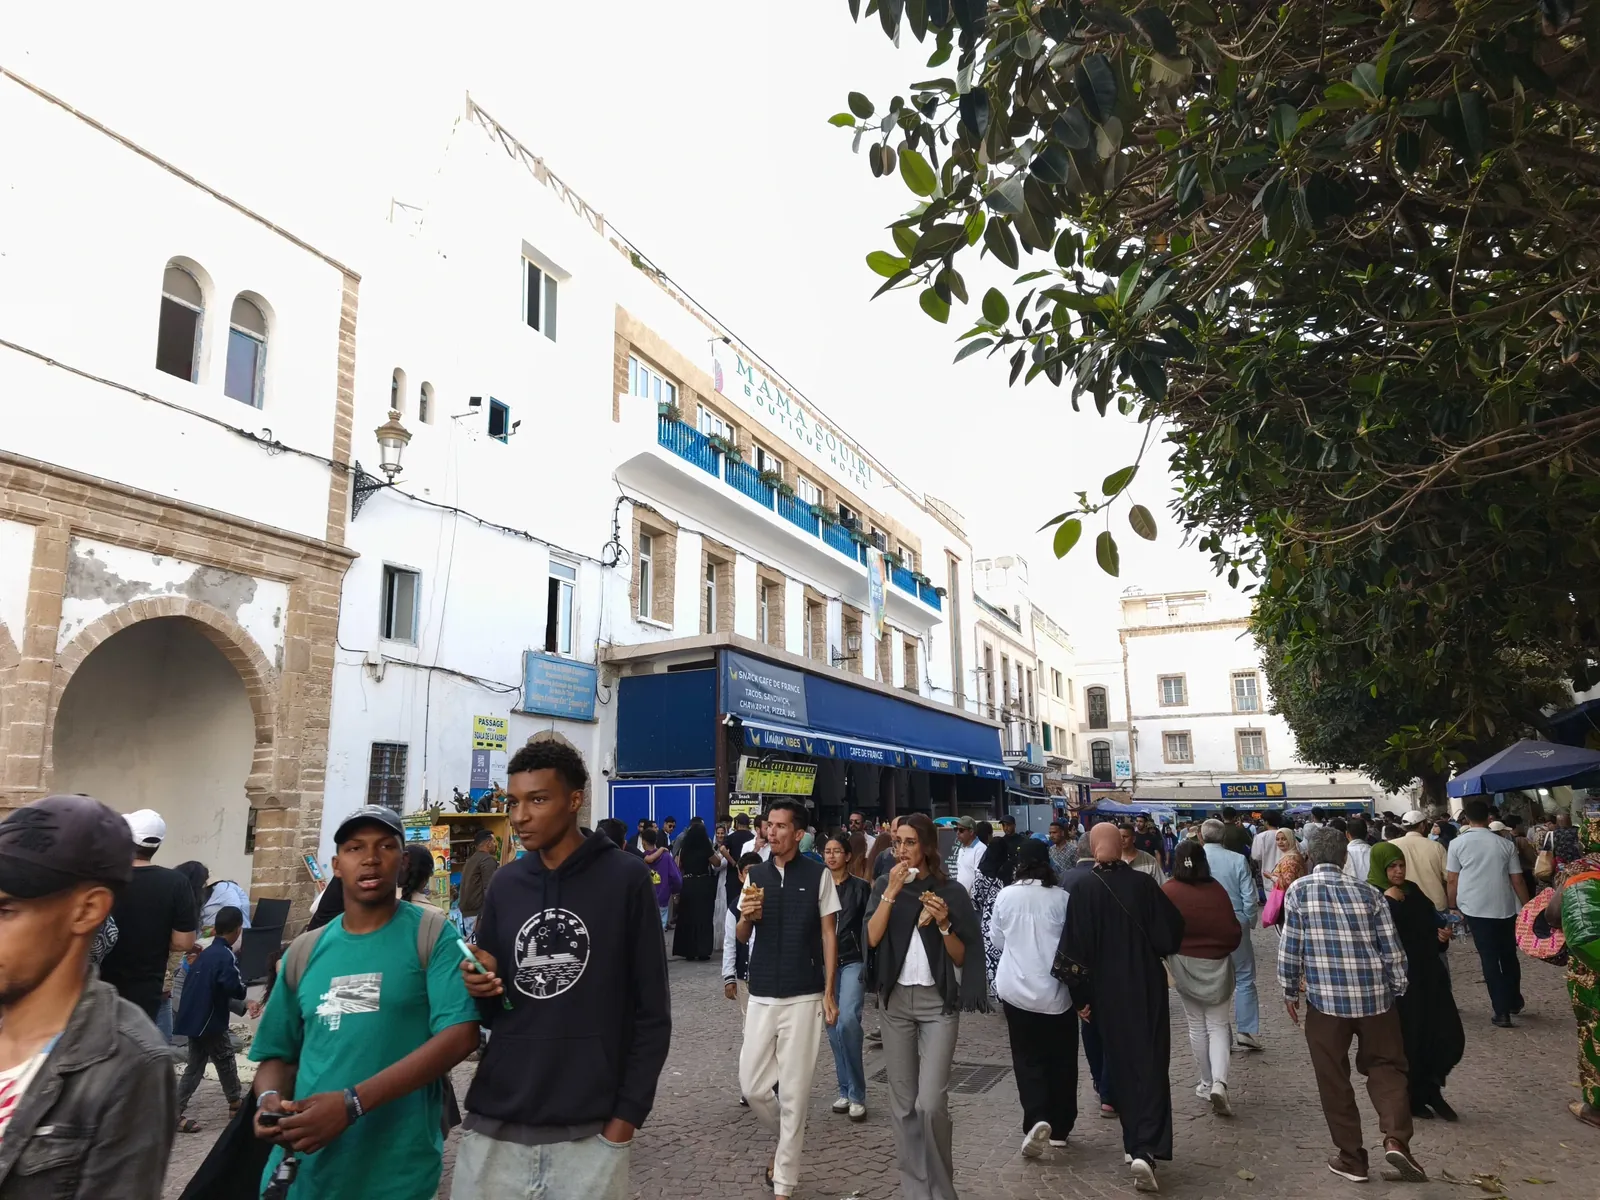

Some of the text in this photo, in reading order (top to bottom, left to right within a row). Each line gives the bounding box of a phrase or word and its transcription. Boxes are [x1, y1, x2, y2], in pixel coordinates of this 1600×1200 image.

[736, 354, 873, 483] MAMA SOUIRI
[744, 384, 868, 490] BOUTIQUE HOTEL
[738, 670, 759, 683] SNACK
[773, 680, 780, 689] DE
[781, 682, 800, 694] FRANCE
[787, 710, 796, 718] JUS
[478, 717, 504, 728] PASSAGE
[764, 731, 801, 749] Unique VIBES
[861, 749, 867, 758] DE
[867, 750, 883, 760] FRANCE
[786, 764, 794, 772] DE
[794, 765, 815, 773] FRANCE
